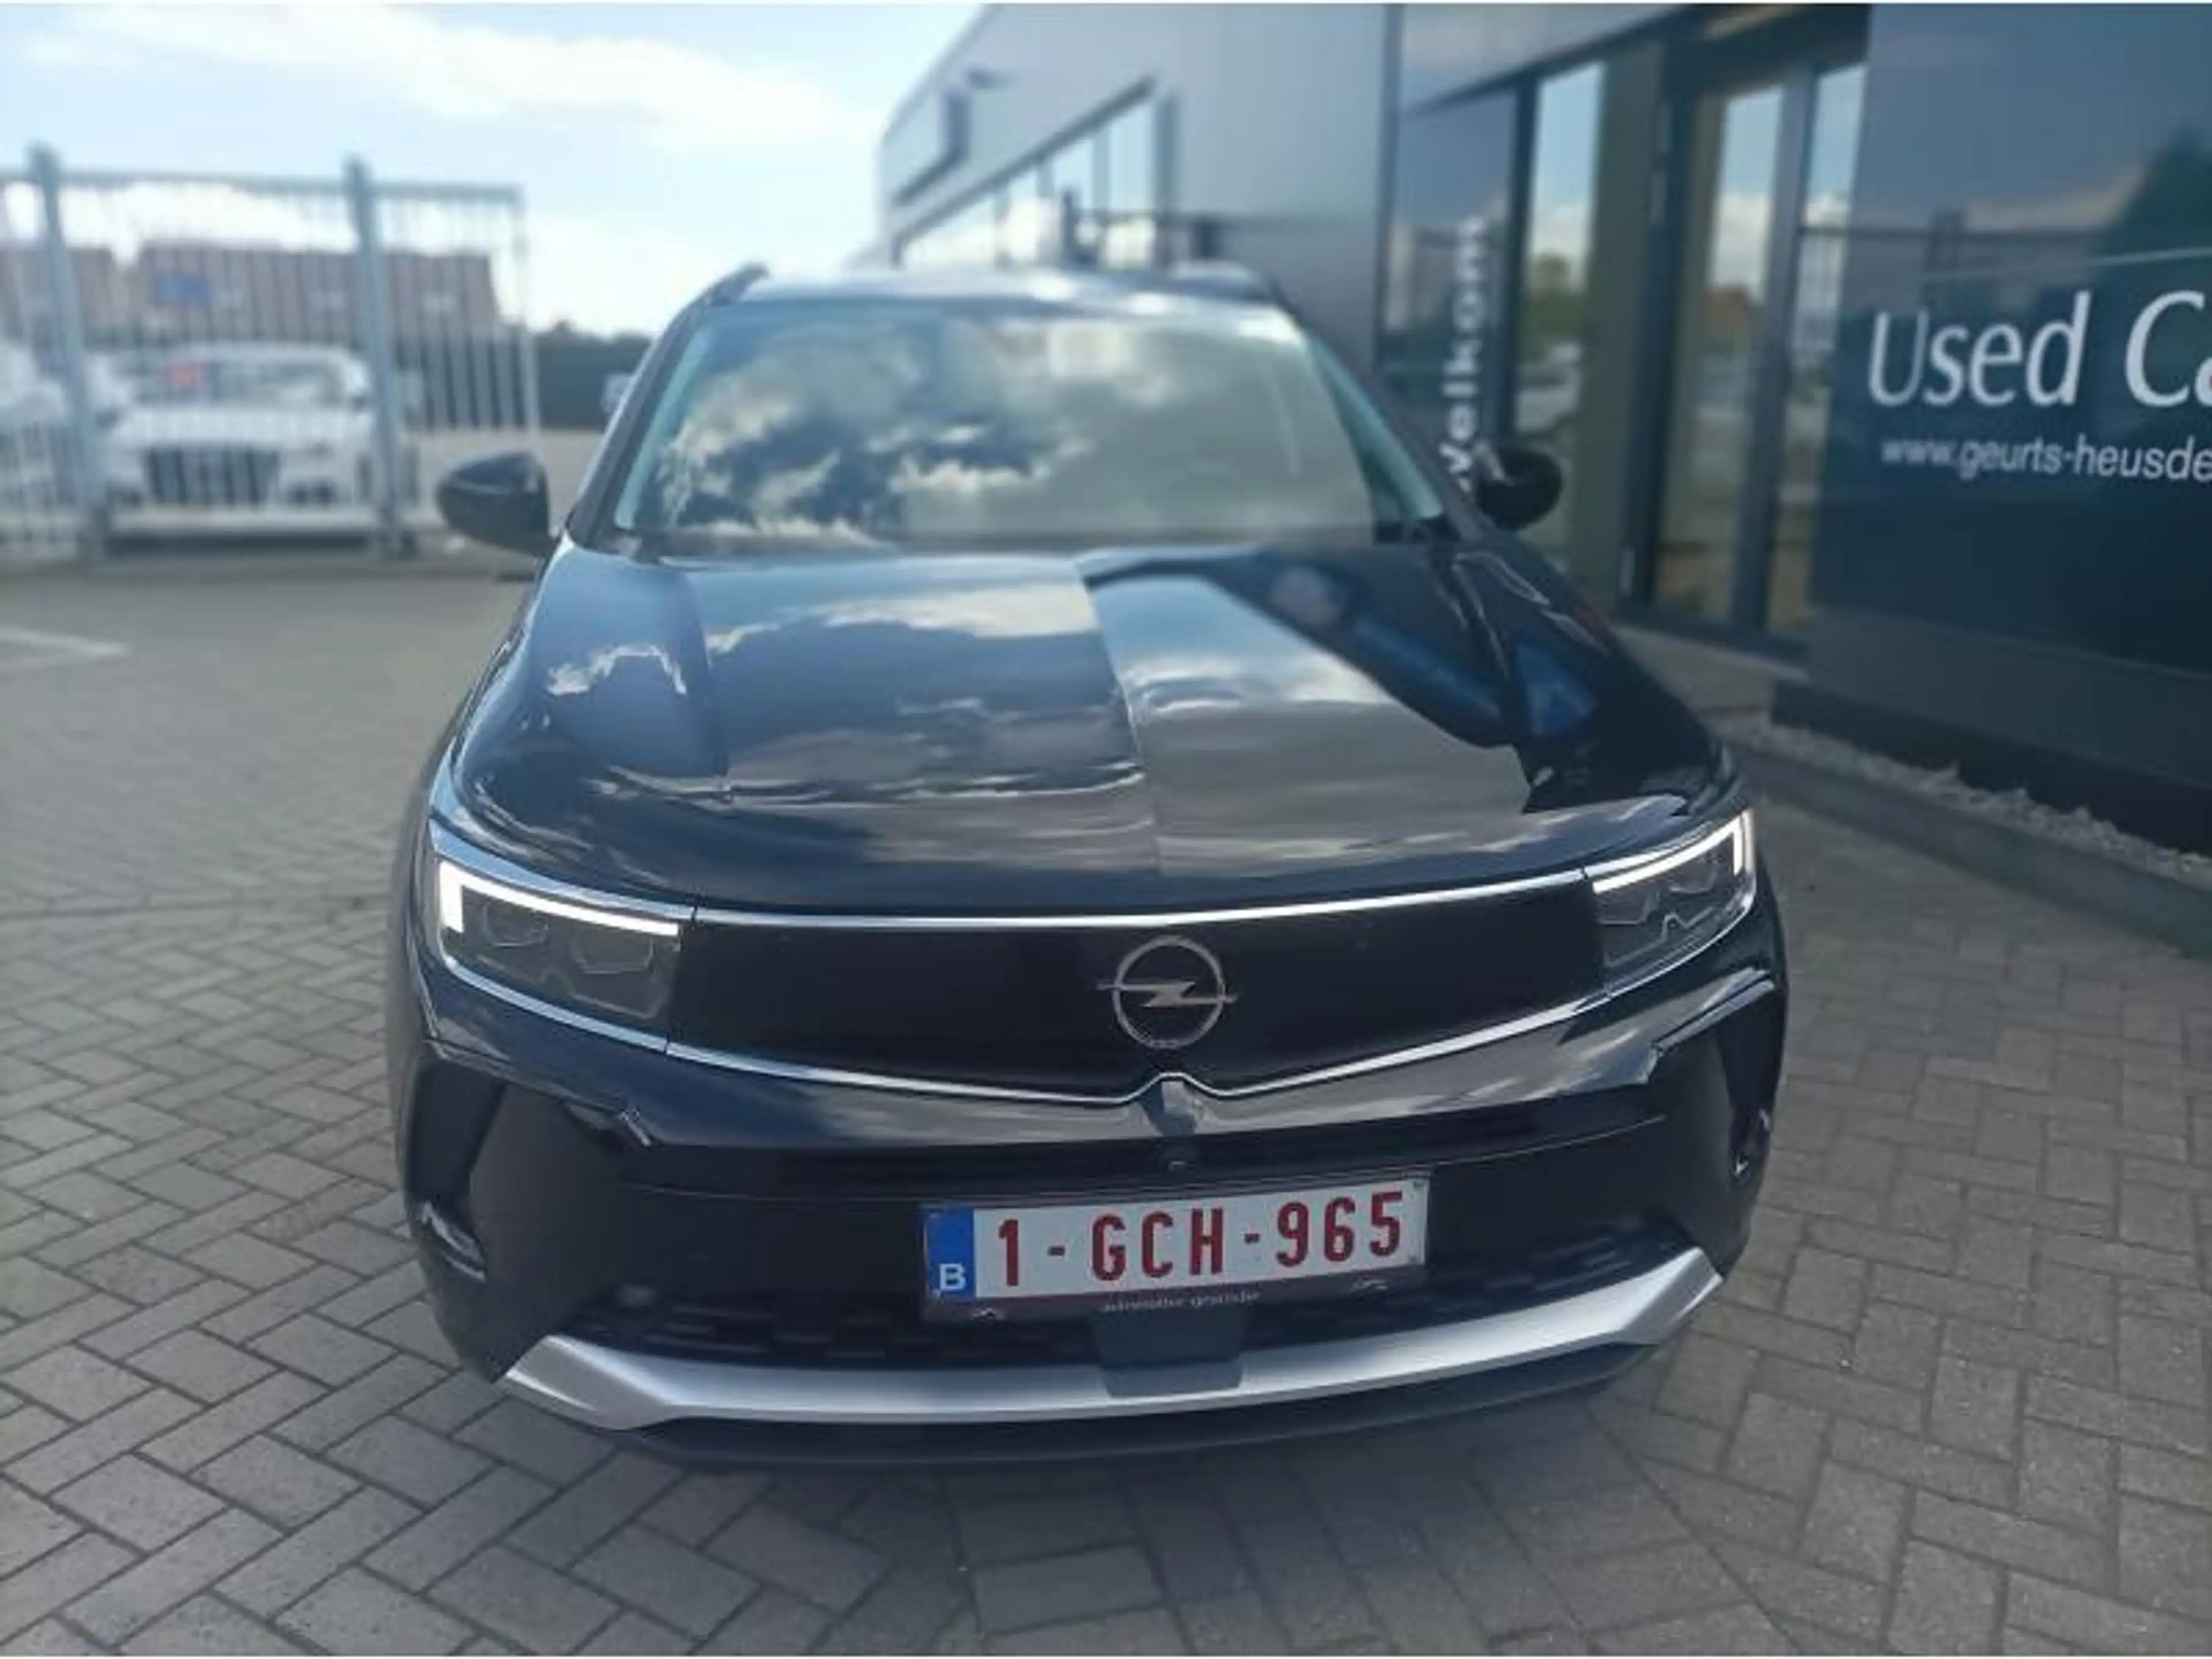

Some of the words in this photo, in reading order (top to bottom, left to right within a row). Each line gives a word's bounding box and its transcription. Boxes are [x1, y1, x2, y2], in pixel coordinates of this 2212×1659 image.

[1868, 290, 2091, 406] Used
[939, 1263, 967, 1291] B
[998, 1191, 1403, 1287] 1-GCH-965
